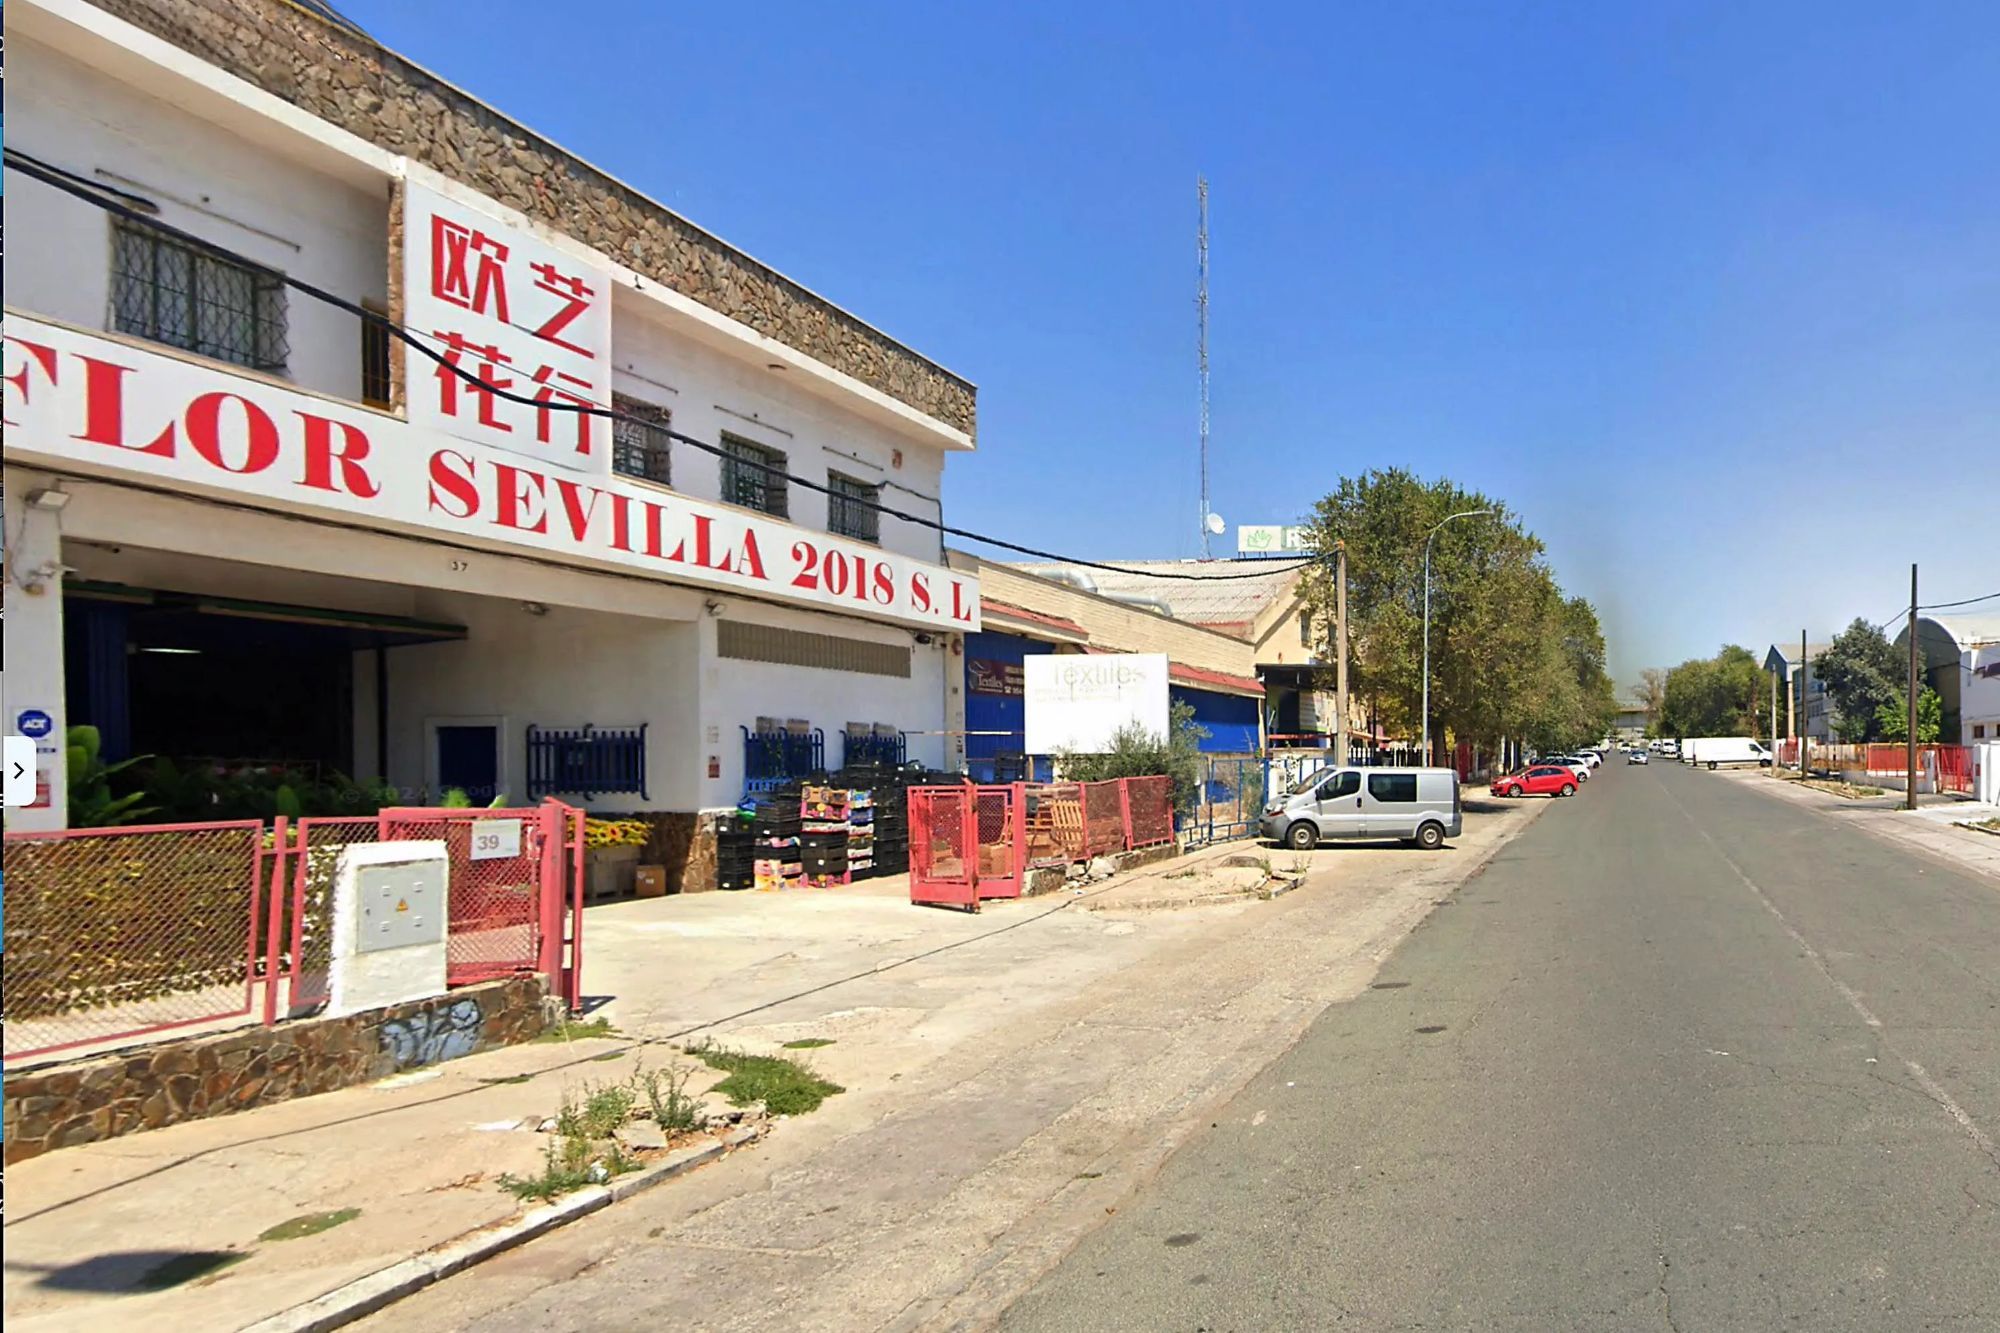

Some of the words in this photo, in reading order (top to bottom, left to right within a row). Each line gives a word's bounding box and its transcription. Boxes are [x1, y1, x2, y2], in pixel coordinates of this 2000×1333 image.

[431, 213, 595, 360] 欧艺
[432, 330, 595, 456] 花行
[427, 447, 770, 580] SEVILLA
[791, 540, 895, 606] 2018
[451, 560, 469, 573] 37
[477, 835, 500, 851] 39
